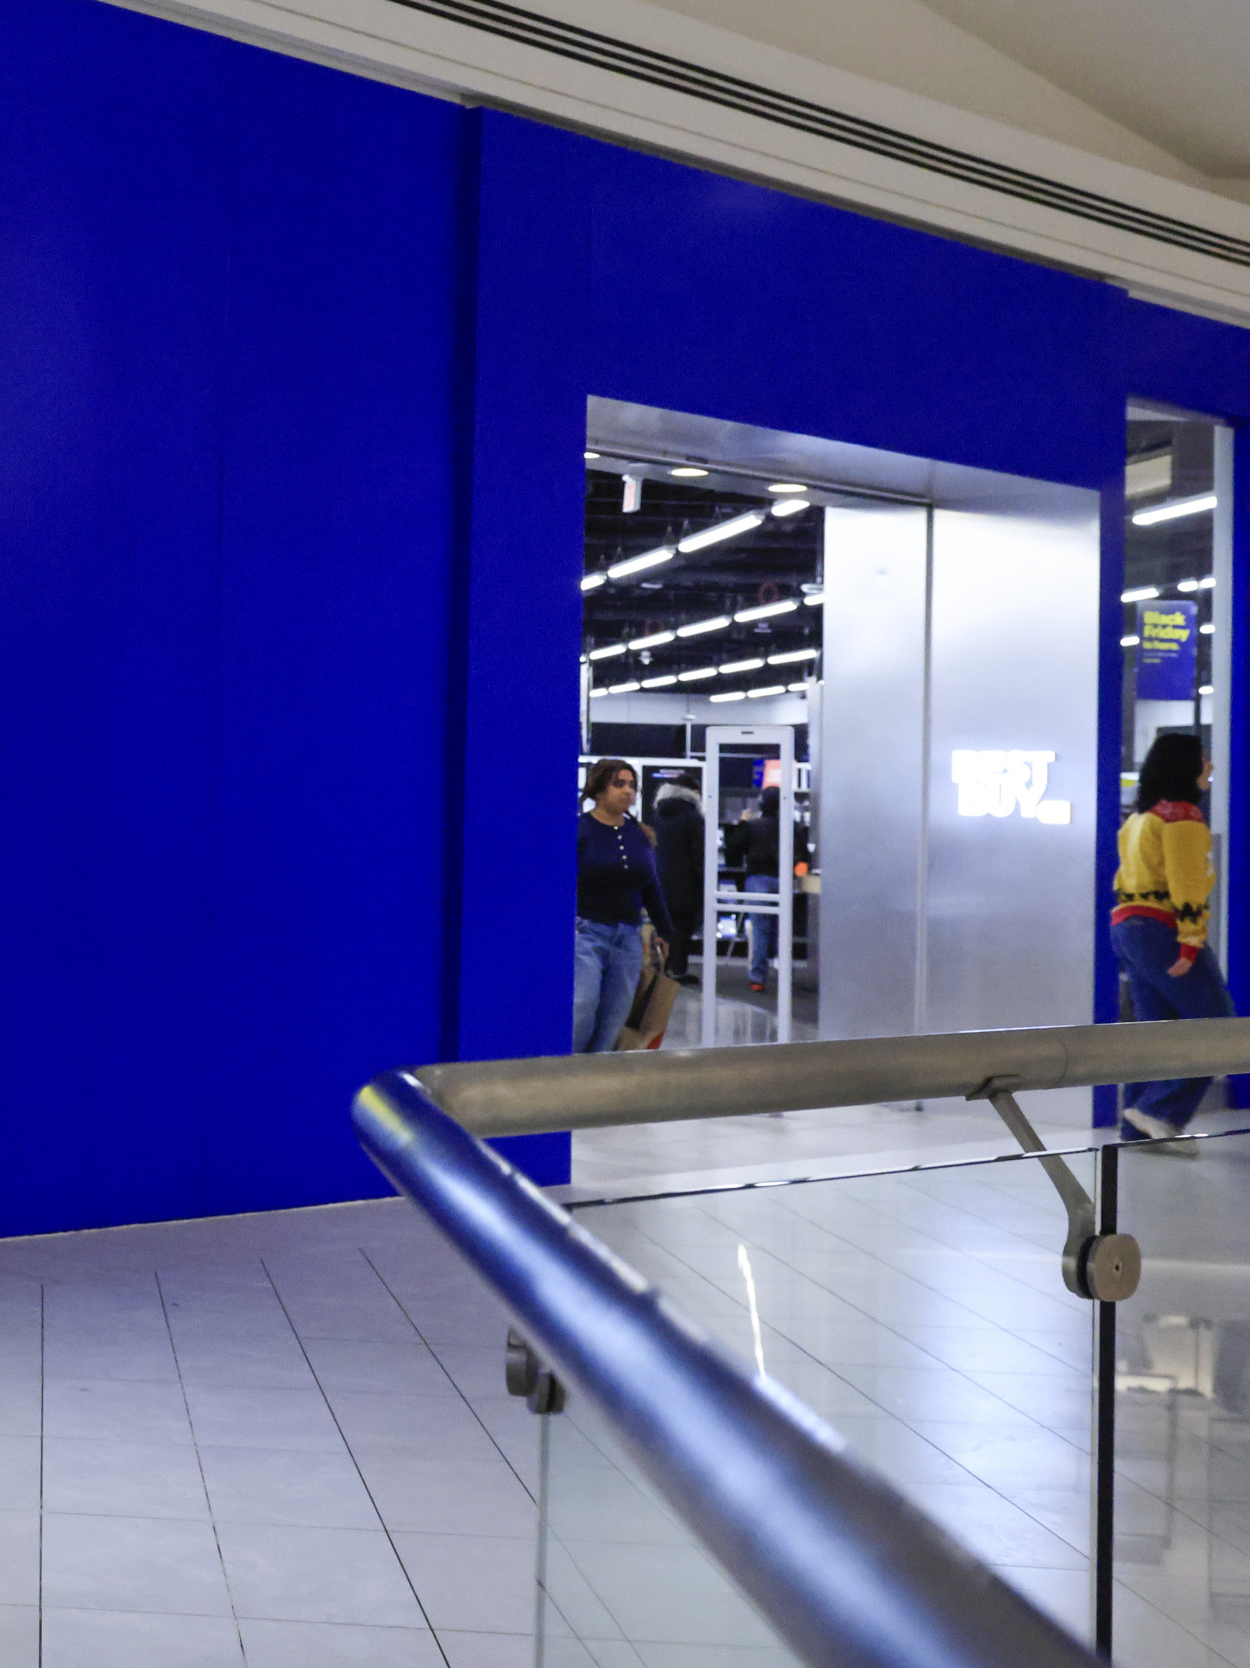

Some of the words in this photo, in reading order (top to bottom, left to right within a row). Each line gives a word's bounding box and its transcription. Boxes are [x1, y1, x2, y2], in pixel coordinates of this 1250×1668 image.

[1143, 625, 1191, 643] Friday
[951, 750, 1056, 784] BEST
[958, 783, 1047, 819] BUY
